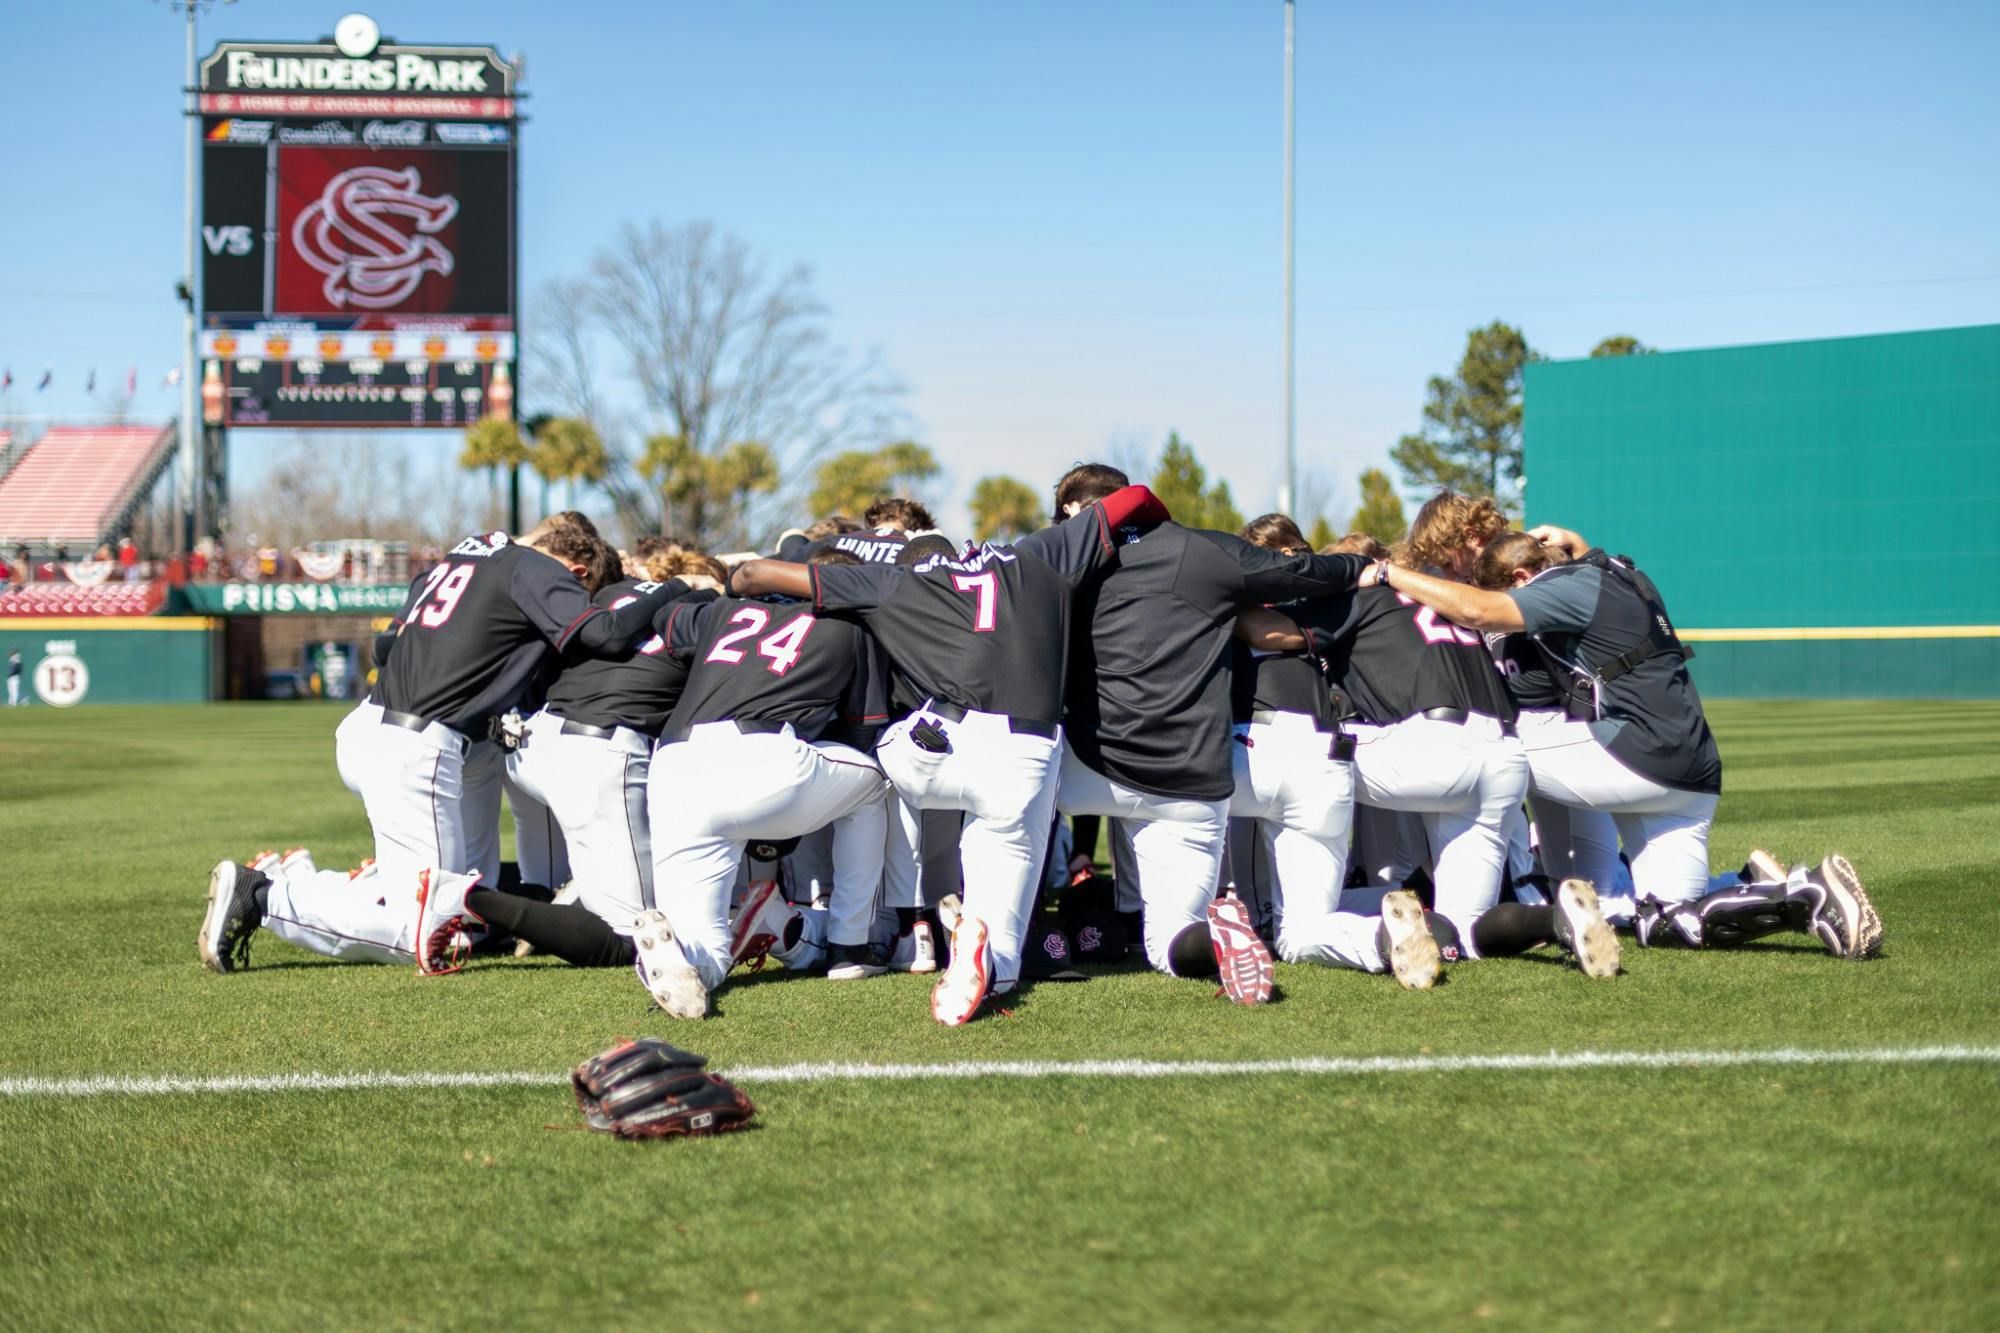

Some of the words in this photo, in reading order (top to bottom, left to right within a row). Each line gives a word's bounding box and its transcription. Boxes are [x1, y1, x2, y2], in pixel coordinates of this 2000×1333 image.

[227, 51, 395, 91] FOUNDERS
[397, 54, 488, 92] PARK
[203, 225, 253, 256] VS
[223, 583, 339, 612] PRISMA
[404, 560, 477, 629] 29
[950, 570, 999, 632] 7
[703, 604, 817, 677] 24
[48, 666, 77, 692] 13
